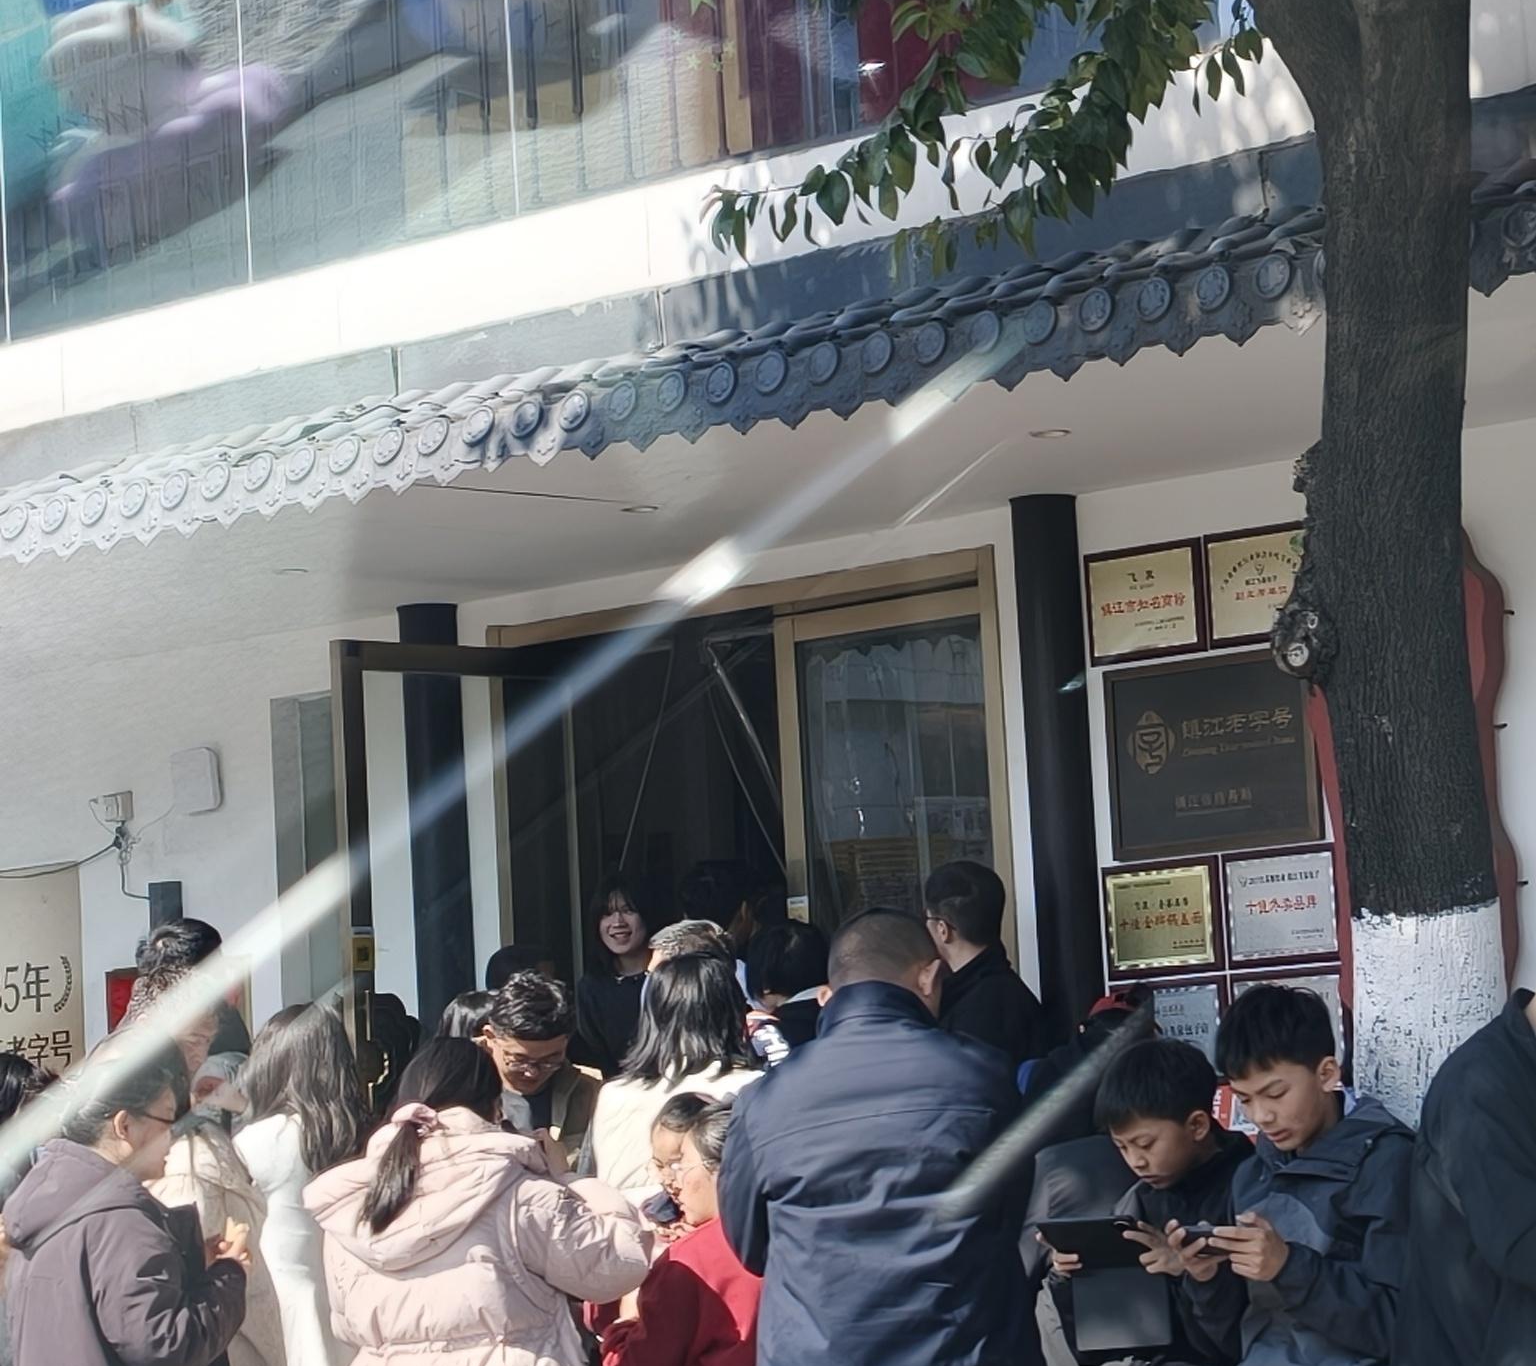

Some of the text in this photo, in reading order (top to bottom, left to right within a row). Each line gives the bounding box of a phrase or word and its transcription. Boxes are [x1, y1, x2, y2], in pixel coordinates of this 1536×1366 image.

[0, 962, 52, 1013] 5年
[0, 1029, 73, 1068] 老字号
